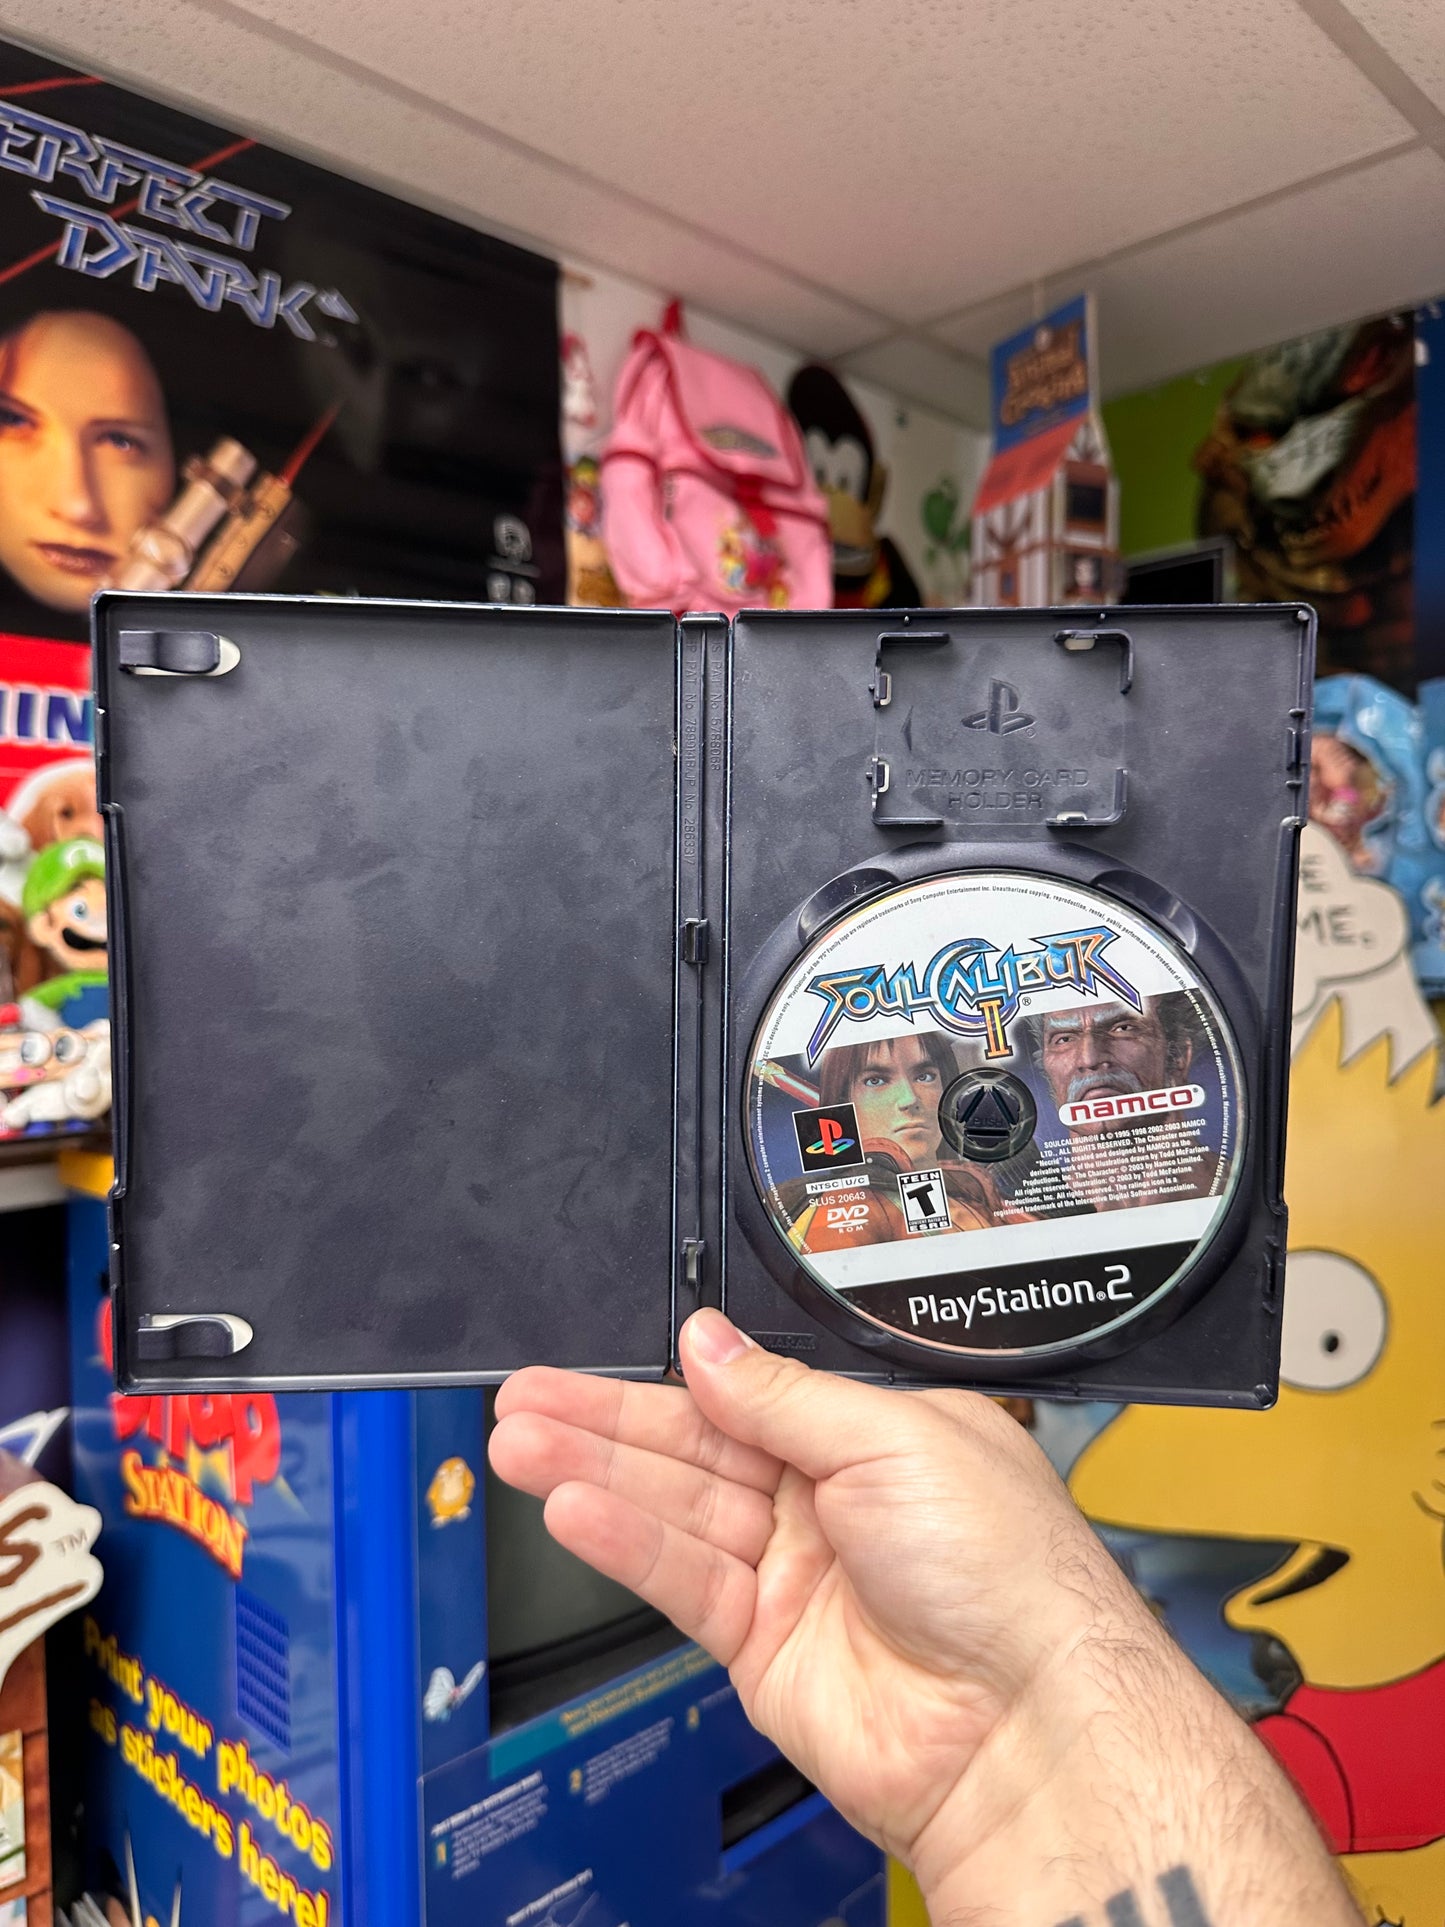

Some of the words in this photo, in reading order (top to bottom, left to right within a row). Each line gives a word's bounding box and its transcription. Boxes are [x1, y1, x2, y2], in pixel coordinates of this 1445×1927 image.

[30, 190, 317, 341] DARK
[906, 768, 1014, 788] MEMORY
[1022, 768, 1090, 788] CARD
[948, 791, 1044, 810] HOLDER
[758, 1144, 769, 1168] computer
[768, 1012, 784, 1040] designation
[805, 965, 814, 974] and
[811, 959, 820, 967] the
[825, 939, 841, 954] Family
[838, 932, 850, 942] logo
[855, 913, 879, 930] registered
[877, 902, 903, 917] trademarks
[909, 896, 922, 904] Sony
[922, 890, 945, 901] Computer
[946, 886, 980, 894] Entertainment
[1028, 889, 1052, 899] copying,
[1052, 894, 1088, 911] reproduction,
[1088, 907, 1106, 920] rental,
[1105, 916, 1122, 929] public
[1121, 926, 1151, 951] performance
[1155, 953, 1176, 975] broadcast
[1183, 989, 1195, 1004] game
[1192, 1003, 1202, 1015] may
[1204, 1026, 1218, 1049] violation
[1214, 1056, 1226, 1084] applicable
[1114, 1129, 1130, 1138] 1995
[1131, 1127, 1147, 1136] 1998
[1148, 1124, 1163, 1133] 2002
[1164, 1122, 1180, 1131] 2003
[1181, 1118, 1206, 1128] NAMCO
[1058, 1147, 1070, 1155] ALL
[1071, 1144, 1096, 1153] RIGHTS
[1096, 1138, 1133, 1150] RESERVED.
[1134, 1136, 1146, 1144] The
[1146, 1131, 1177, 1142] Character
[1178, 1128, 1200, 1137] named
[1070, 1152, 1094, 1162] created
[1107, 1146, 1136, 1158] designed
[1137, 1145, 1145, 1154] by
[1146, 1141, 1170, 1151] NAMCO
[1180, 1138, 1191, 1146] the
[1029, 1166, 1059, 1177] derivative
[1060, 1164, 1075, 1172] work
[1083, 1161, 1094, 1169] the
[1129, 1153, 1149, 1162] drawn
[1150, 1152, 1158, 1161] by
[1158, 1149, 1175, 1158] Todd
[1175, 1144, 1209, 1156] McFarlane
[1061, 1173, 1073, 1181] Inc.
[1074, 1171, 1086, 1179] The
[1087, 1166, 1119, 1177] Character:
[1128, 1162, 1144, 1171] 2003
[1145, 1161, 1153, 1170] by
[1153, 1158, 1176, 1168] Namco
[1176, 1154, 1203, 1164] Limited.
[811, 1181, 839, 1191] NTSC
[845, 1177, 865, 1186] U/C
[901, 1172, 939, 1184] TEEN
[1024, 1186, 1042, 1196] rights
[1116, 1173, 1132, 1182] 2003
[1133, 1172, 1141, 1180] by
[1141, 1169, 1158, 1178] Todd
[1158, 1164, 1192, 1175] McFarlane
[1043, 1193, 1055, 1201] Inc.
[1056, 1191, 1065, 1199] All
[1066, 1189, 1084, 1199] rights
[1084, 1184, 1113, 1195] reserved.
[1115, 1182, 1127, 1190] The
[1127, 1179, 1150, 1190] ratings
[1150, 1177, 1164, 1185] icon
[808, 1197, 836, 1208] SLUS
[838, 1192, 866, 1204] 20643
[906, 1183, 936, 1217] T
[993, 1206, 1024, 1218] registered
[1024, 1202, 1056, 1212] trademark
[1064, 1199, 1074, 1207] the
[1075, 1194, 1107, 1205] Interactive
[1108, 1191, 1129, 1202] Digital
[1130, 1187, 1157, 1197] Software
[1158, 1181, 1197, 1193] Association.
[827, 1204, 870, 1222] DVD
[839, 1225, 864, 1234] ROM
[909, 1221, 950, 1232] ESRB
[147, 1674, 216, 1759] your
[216, 1738, 334, 1871] photos
[120, 1721, 236, 1859] stickers
